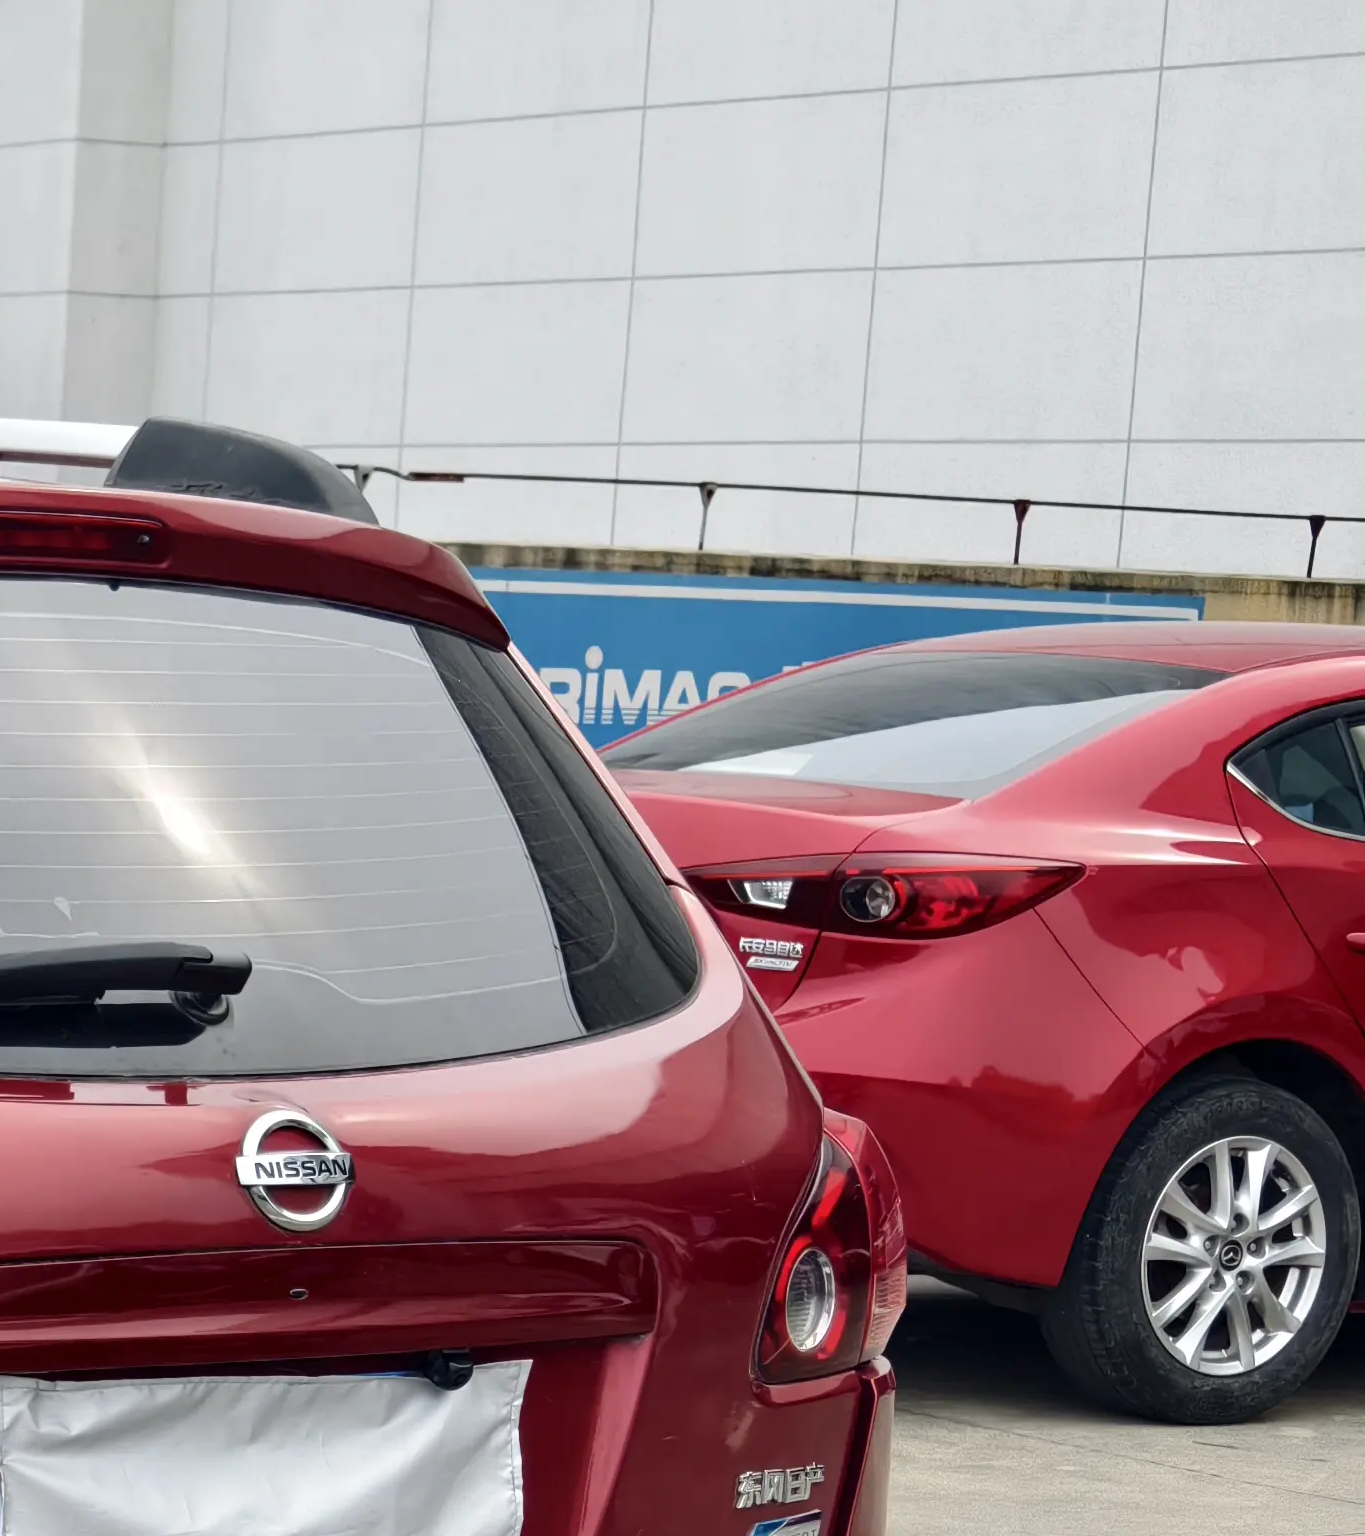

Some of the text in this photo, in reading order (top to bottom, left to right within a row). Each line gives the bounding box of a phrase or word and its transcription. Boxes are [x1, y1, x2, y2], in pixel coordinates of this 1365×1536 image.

[254, 1159, 348, 1180] NISSAN
[735, 1462, 825, 1509] 东风日产
